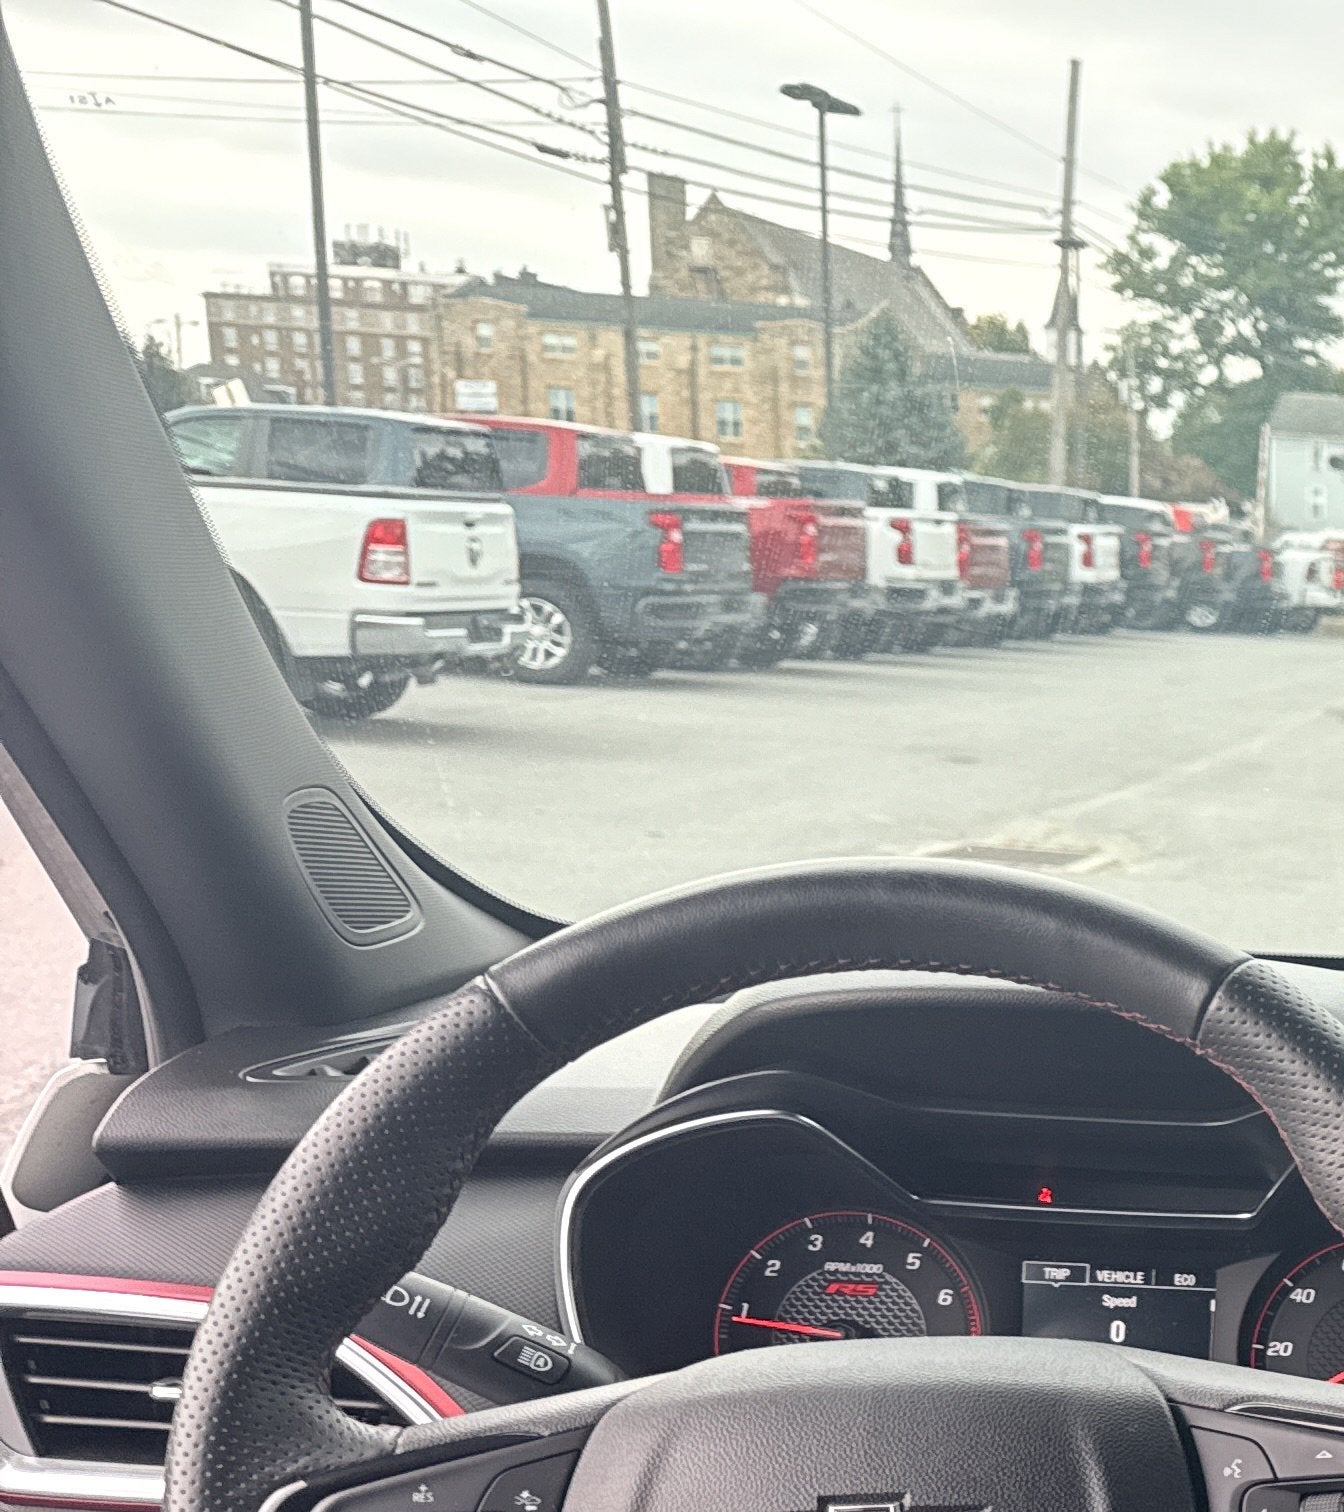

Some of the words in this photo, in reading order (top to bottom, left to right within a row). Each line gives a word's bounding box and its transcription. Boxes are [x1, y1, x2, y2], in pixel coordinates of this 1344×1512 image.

[764, 1259, 781, 1277] 2
[808, 1234, 823, 1251] 3
[859, 1231, 874, 1248] 4
[906, 1253, 922, 1270] 5
[937, 1288, 953, 1306] 6
[1043, 1267, 1070, 1281] TRIP
[1096, 1270, 1145, 1285] VEHICLE
[1174, 1273, 1196, 1286] ECO
[825, 1282, 879, 1296] RS
[1289, 1287, 1316, 1304] 40
[1102, 1295, 1137, 1309] Speed
[1110, 1320, 1126, 1343] 0
[1266, 1341, 1293, 1357] 20
[412, 1491, 434, 1503] RES
